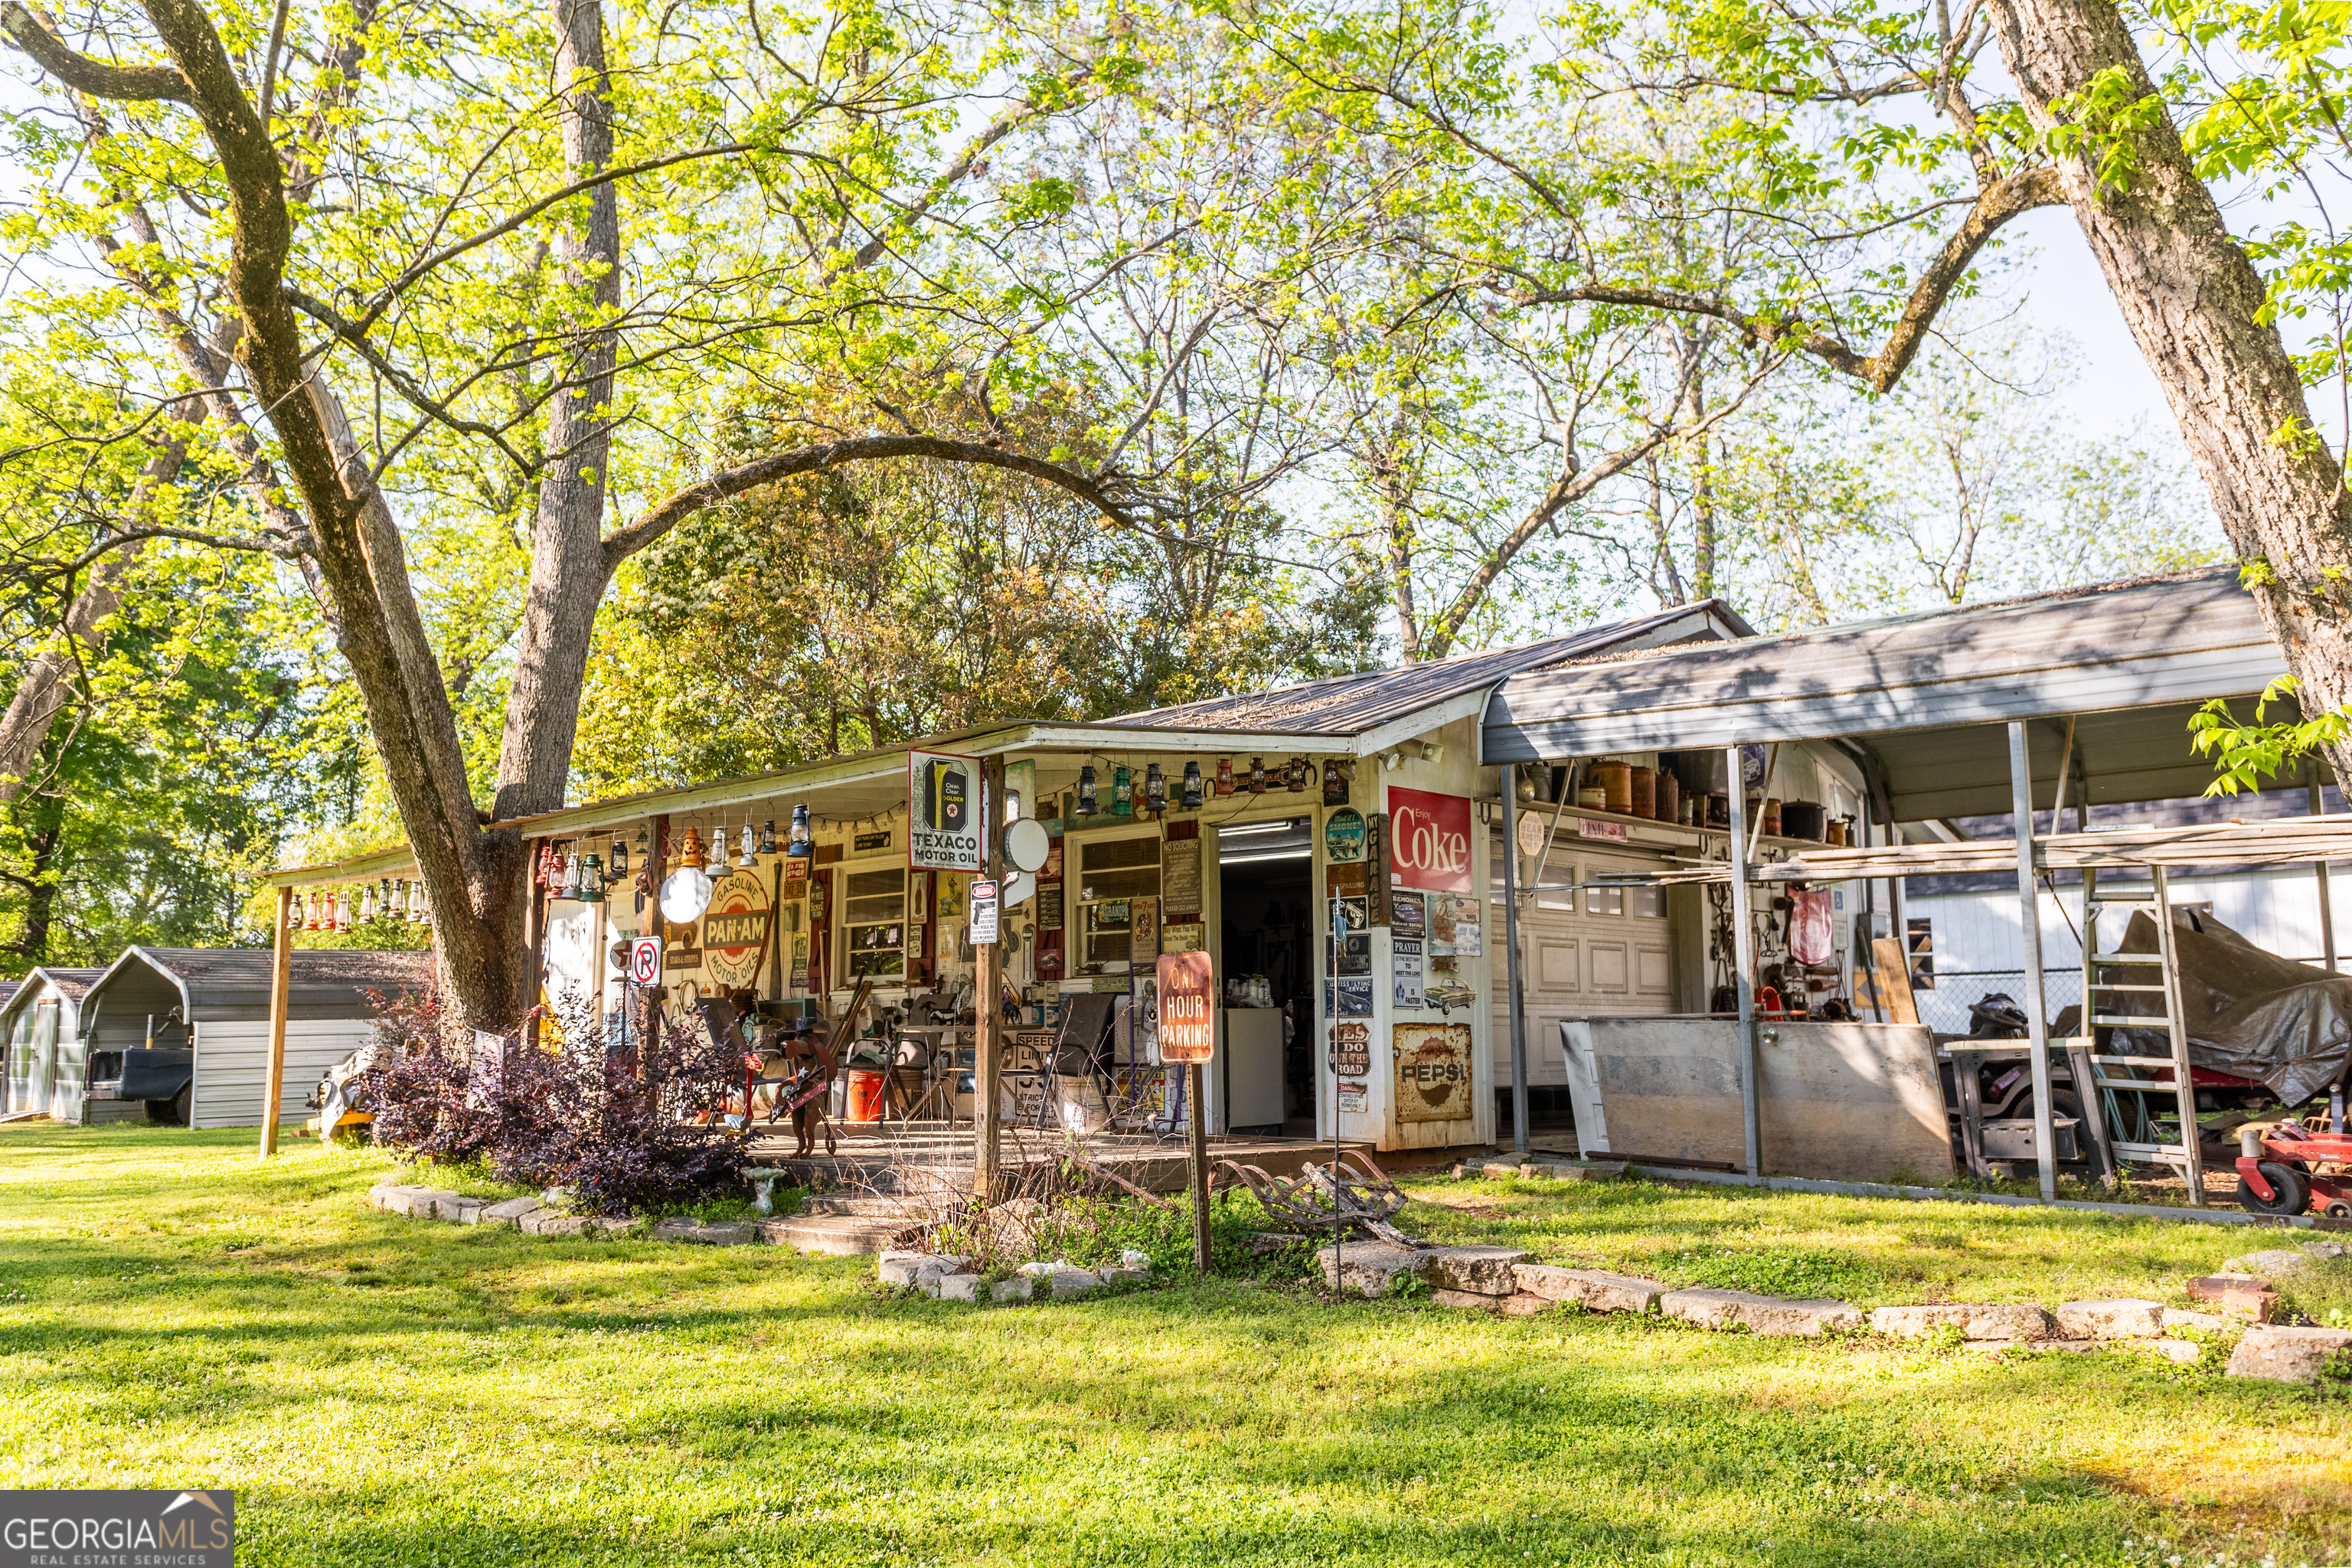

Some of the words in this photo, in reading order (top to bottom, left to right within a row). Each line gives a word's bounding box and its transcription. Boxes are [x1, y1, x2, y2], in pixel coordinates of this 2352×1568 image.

[1263, 773, 1282, 783] UCKLE
[1415, 808, 1431, 820] Enjoy
[1329, 822, 1361, 831] SMOKE?
[1368, 816, 1378, 829] MY
[913, 833, 977, 851] TEXACO
[1164, 844, 1172, 852] NO
[1172, 841, 1199, 851] SOLICITING
[1392, 806, 1466, 874] Coke
[915, 848, 956, 861] MOTOR
[959, 852, 978, 864] OIL
[1368, 830, 1379, 923] GARAGE
[717, 877, 759, 902] GASOLINE
[1142, 902, 1147, 911] 7
[707, 916, 765, 943] PAN-AM
[1395, 942, 1421, 953] PRAYER
[641, 950, 652, 975] P
[741, 952, 760, 979] OILS
[1167, 995, 1204, 1019] HOUR
[1162, 1023, 1210, 1047] PARKING
[1332, 1026, 1366, 1041] YES
[1019, 1036, 1054, 1047] SPEED
[1344, 1043, 1364, 1052] DO
[1022, 1050, 1050, 1060] LIIT
[1350, 1053, 1368, 1064] THE
[1402, 1063, 1465, 1082] PEPSI
